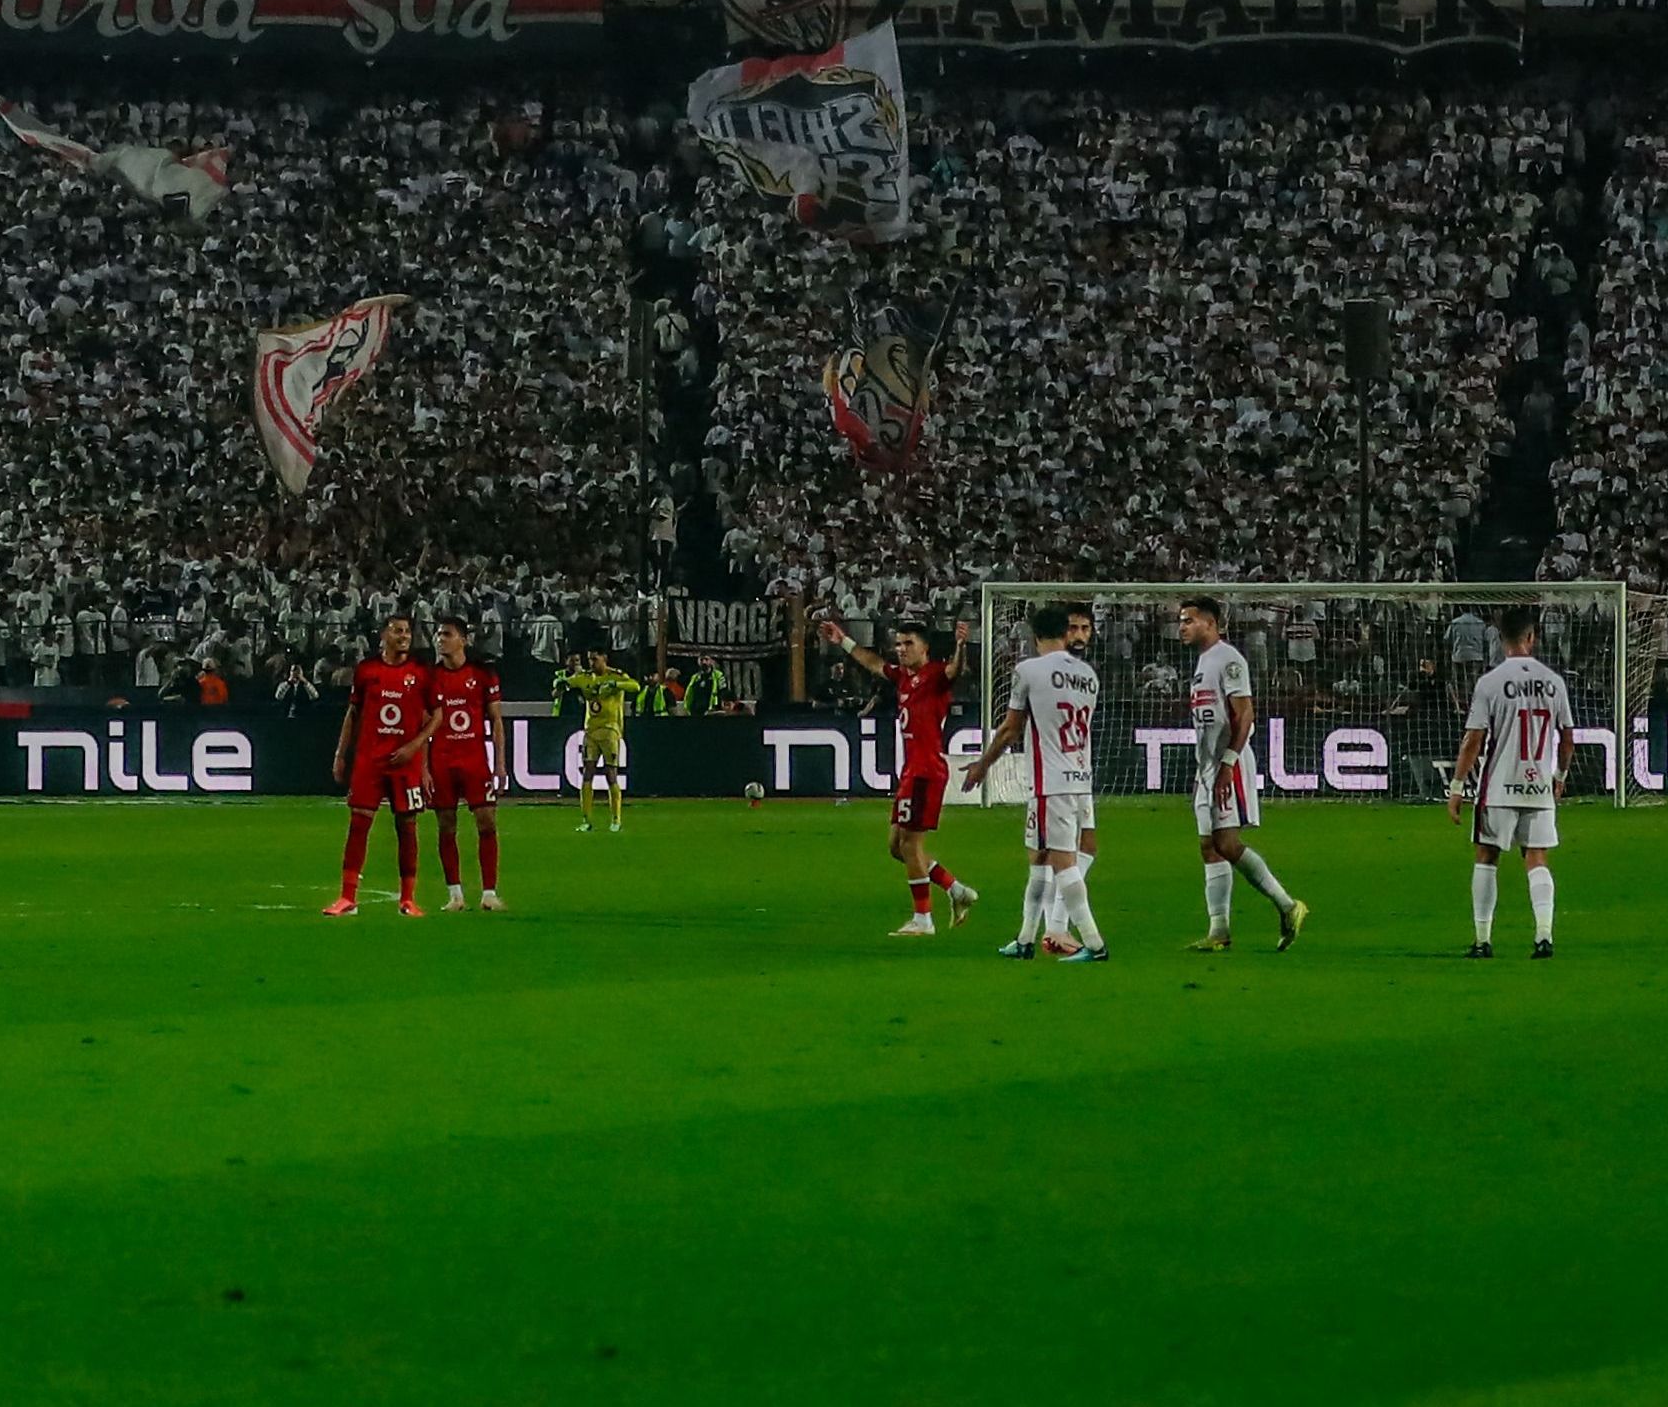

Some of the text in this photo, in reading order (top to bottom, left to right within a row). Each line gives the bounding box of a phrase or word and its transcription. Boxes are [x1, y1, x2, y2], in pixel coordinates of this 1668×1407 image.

[674, 598, 787, 644] VIRAGE
[1051, 671, 1097, 695] ONIRO
[1504, 680, 1556, 699] ONIRO
[1518, 709, 1551, 761] 17
[405, 786, 424, 810] 15
[1504, 784, 1551, 795] TRAV
